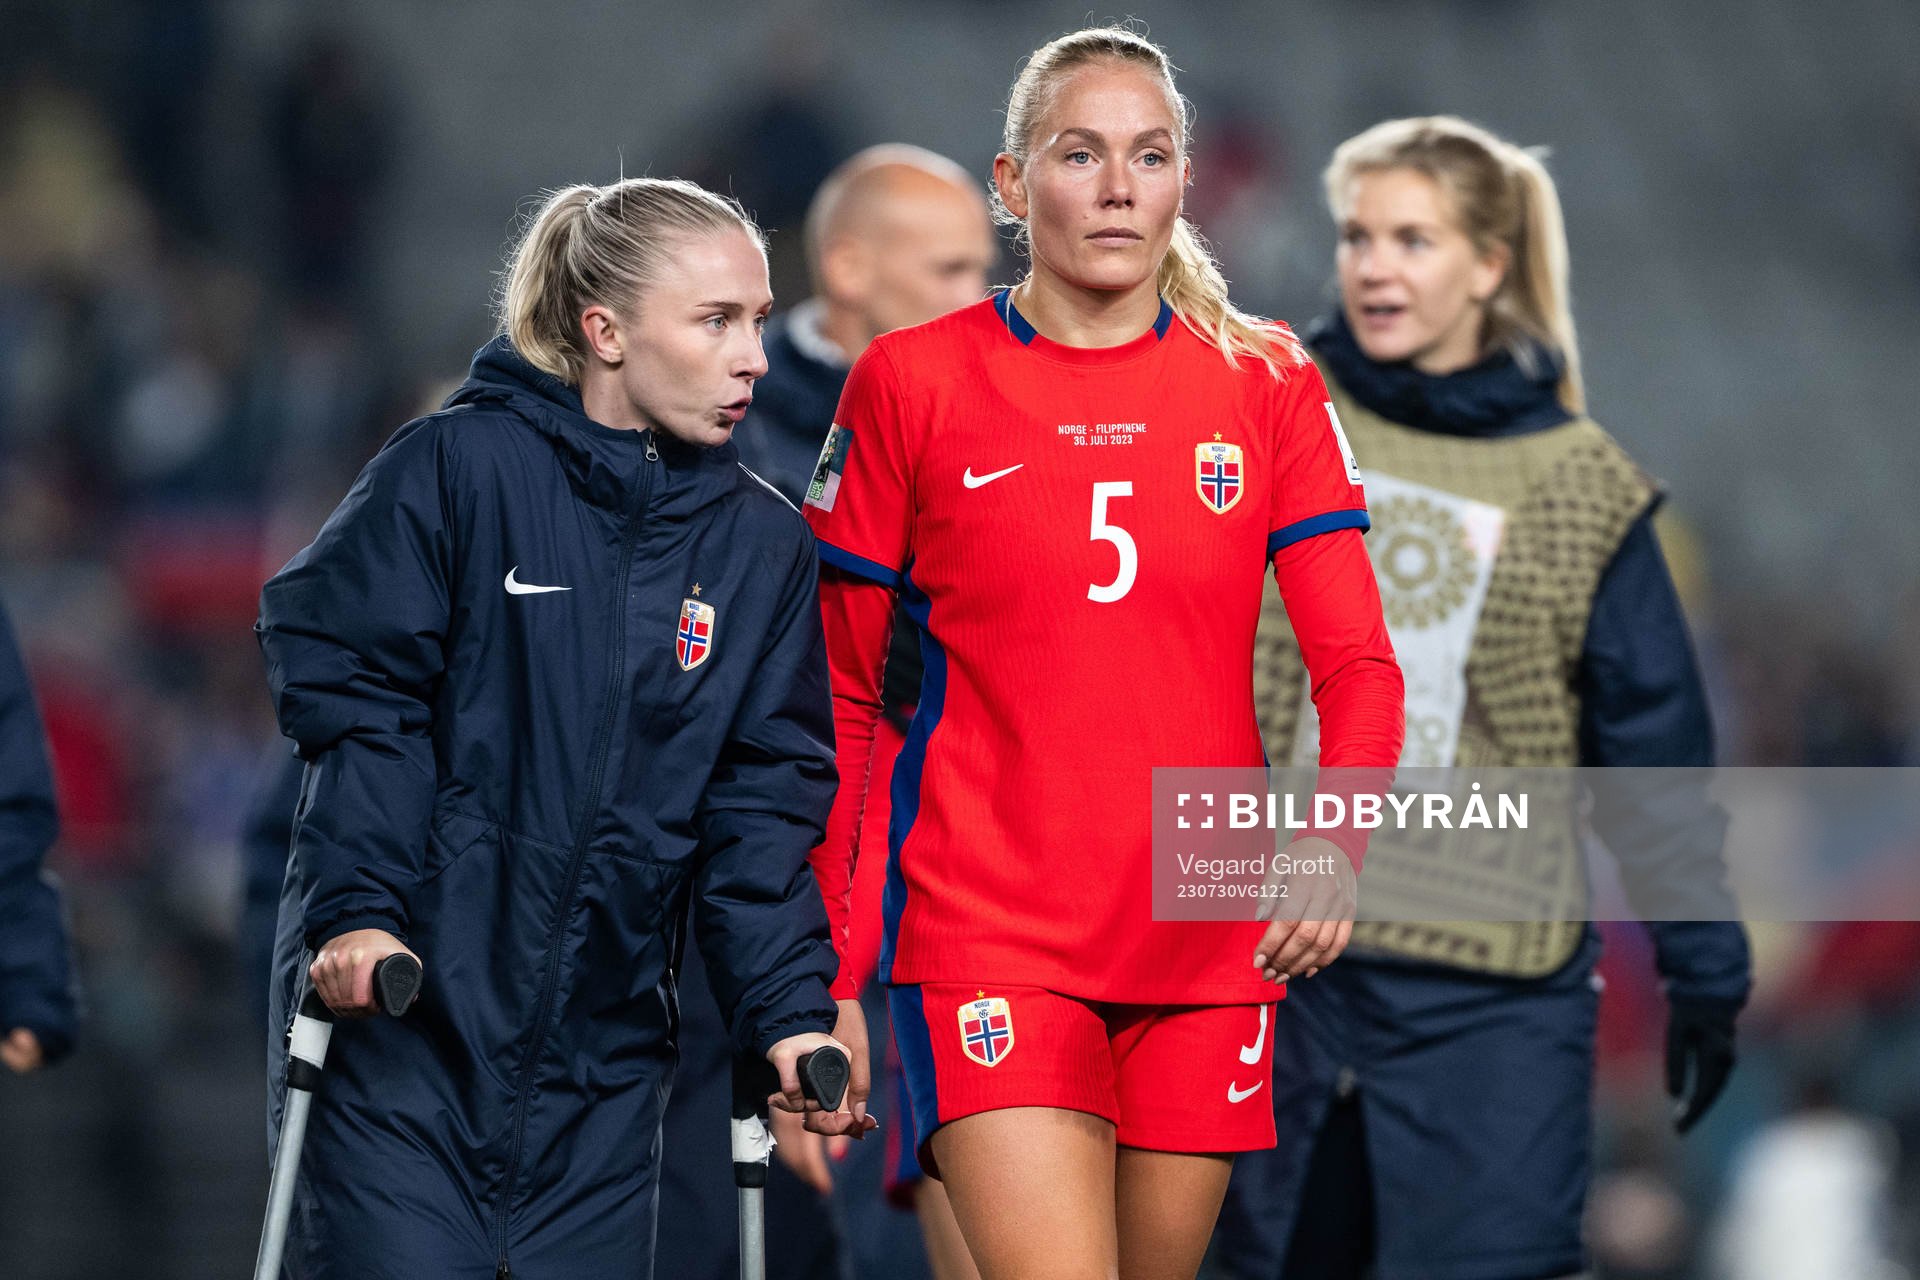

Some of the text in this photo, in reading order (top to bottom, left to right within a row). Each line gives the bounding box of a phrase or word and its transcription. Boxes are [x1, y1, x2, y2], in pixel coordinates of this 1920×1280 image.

[1058, 425, 1087, 435] NORGE
[1096, 423, 1147, 434] FILIPPINENE
[1073, 435, 1133, 446] 30. JULI 2023
[1087, 480, 1138, 603] 5
